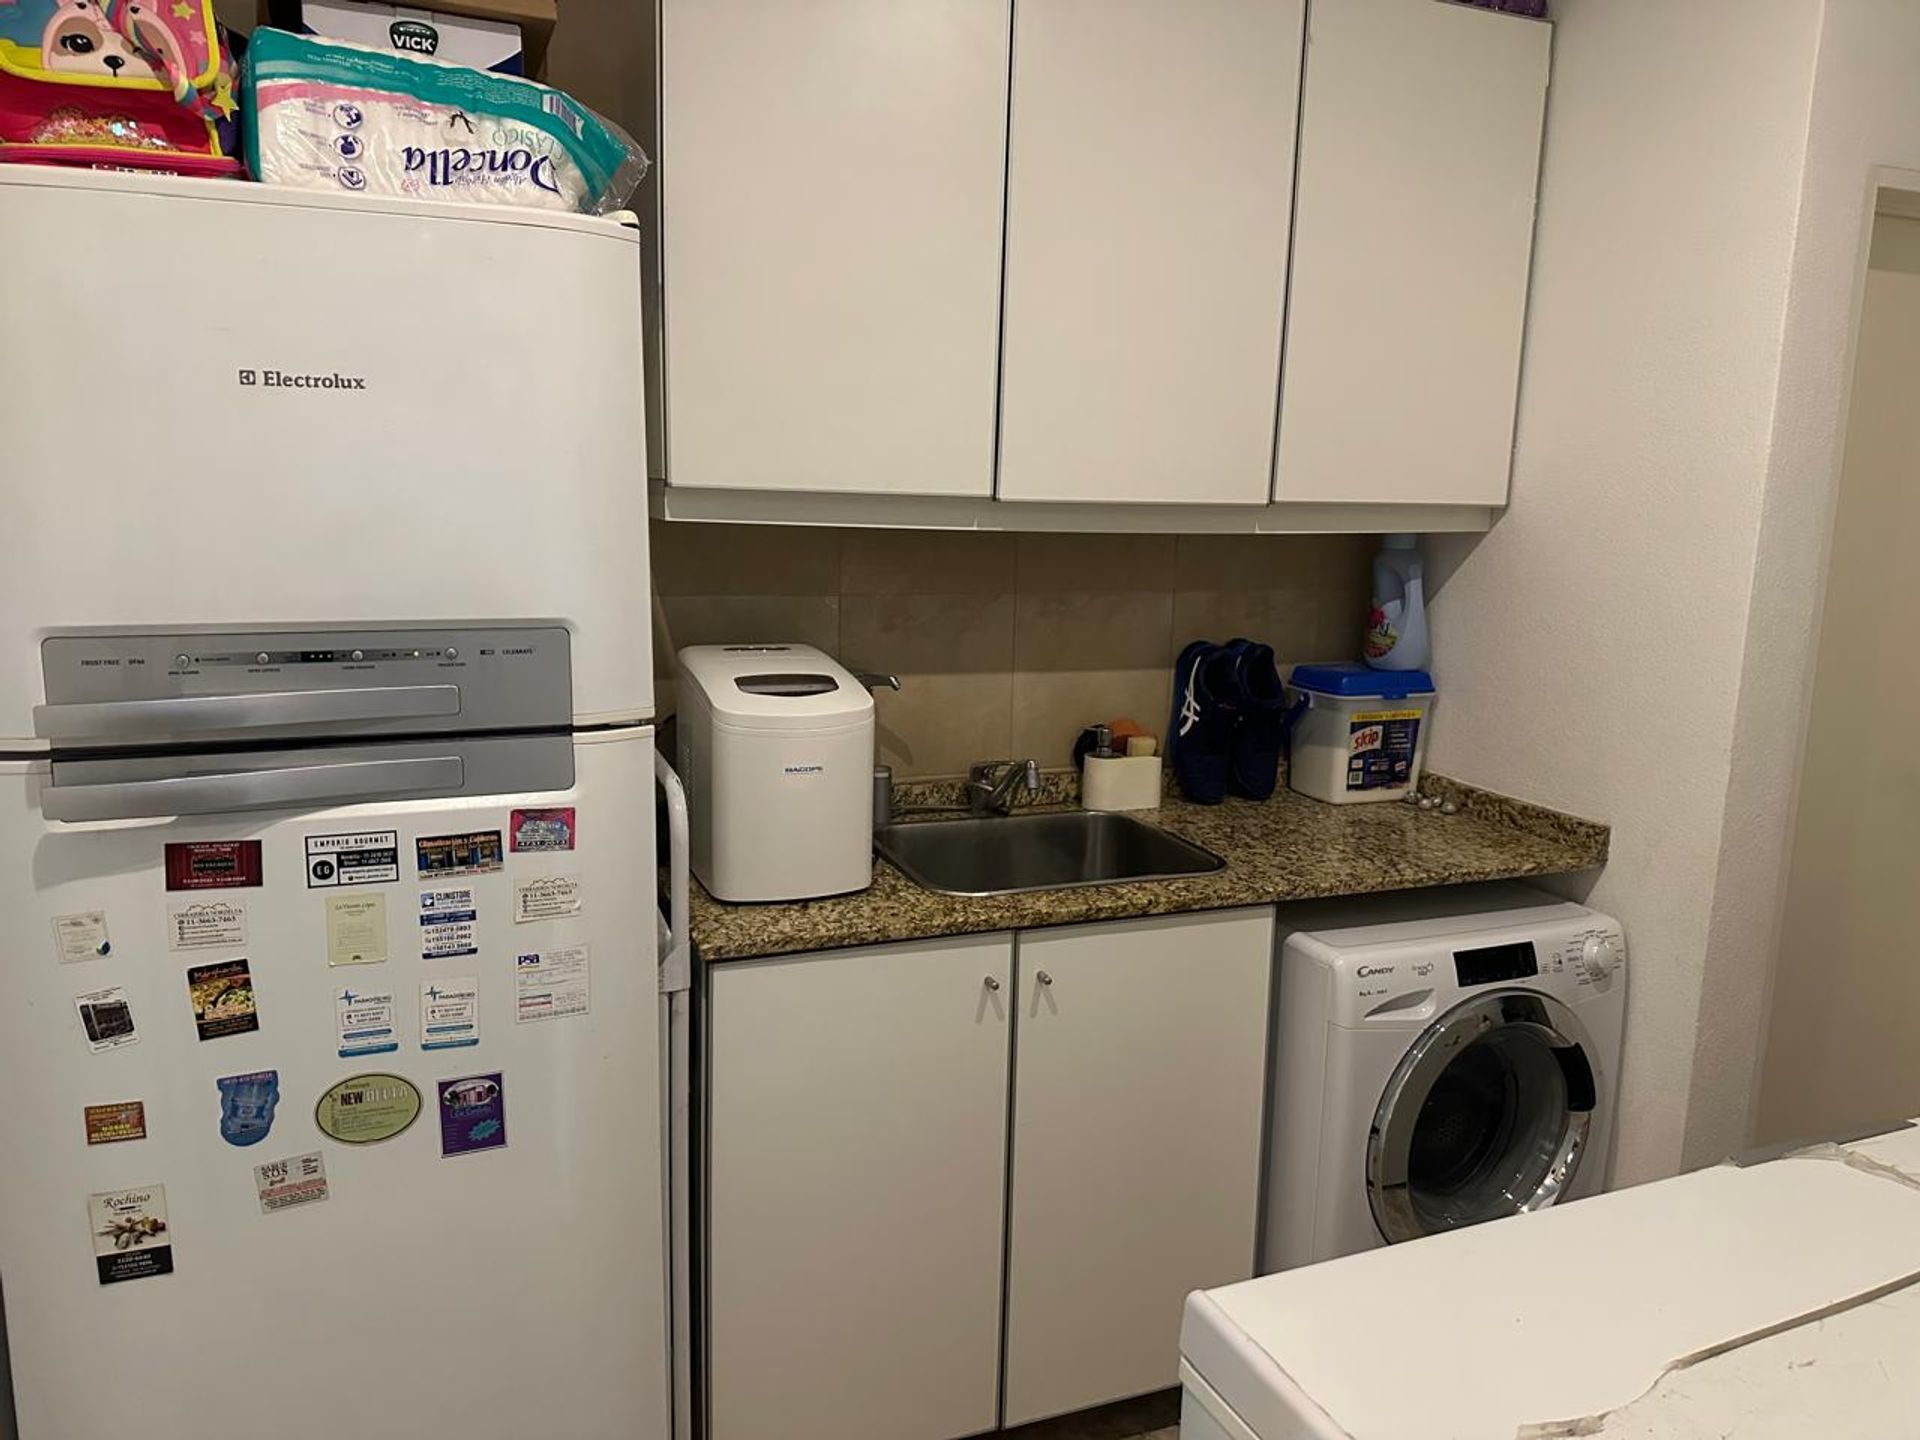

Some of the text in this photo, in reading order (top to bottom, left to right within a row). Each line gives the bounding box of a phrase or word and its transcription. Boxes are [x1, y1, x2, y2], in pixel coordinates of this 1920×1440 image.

[393, 34, 433, 52] VICK
[401, 146, 562, 195] Doncella
[262, 369, 366, 390] Electrolux
[1357, 965, 1395, 978] CANDY
[340, 1091, 364, 1107] NEW
